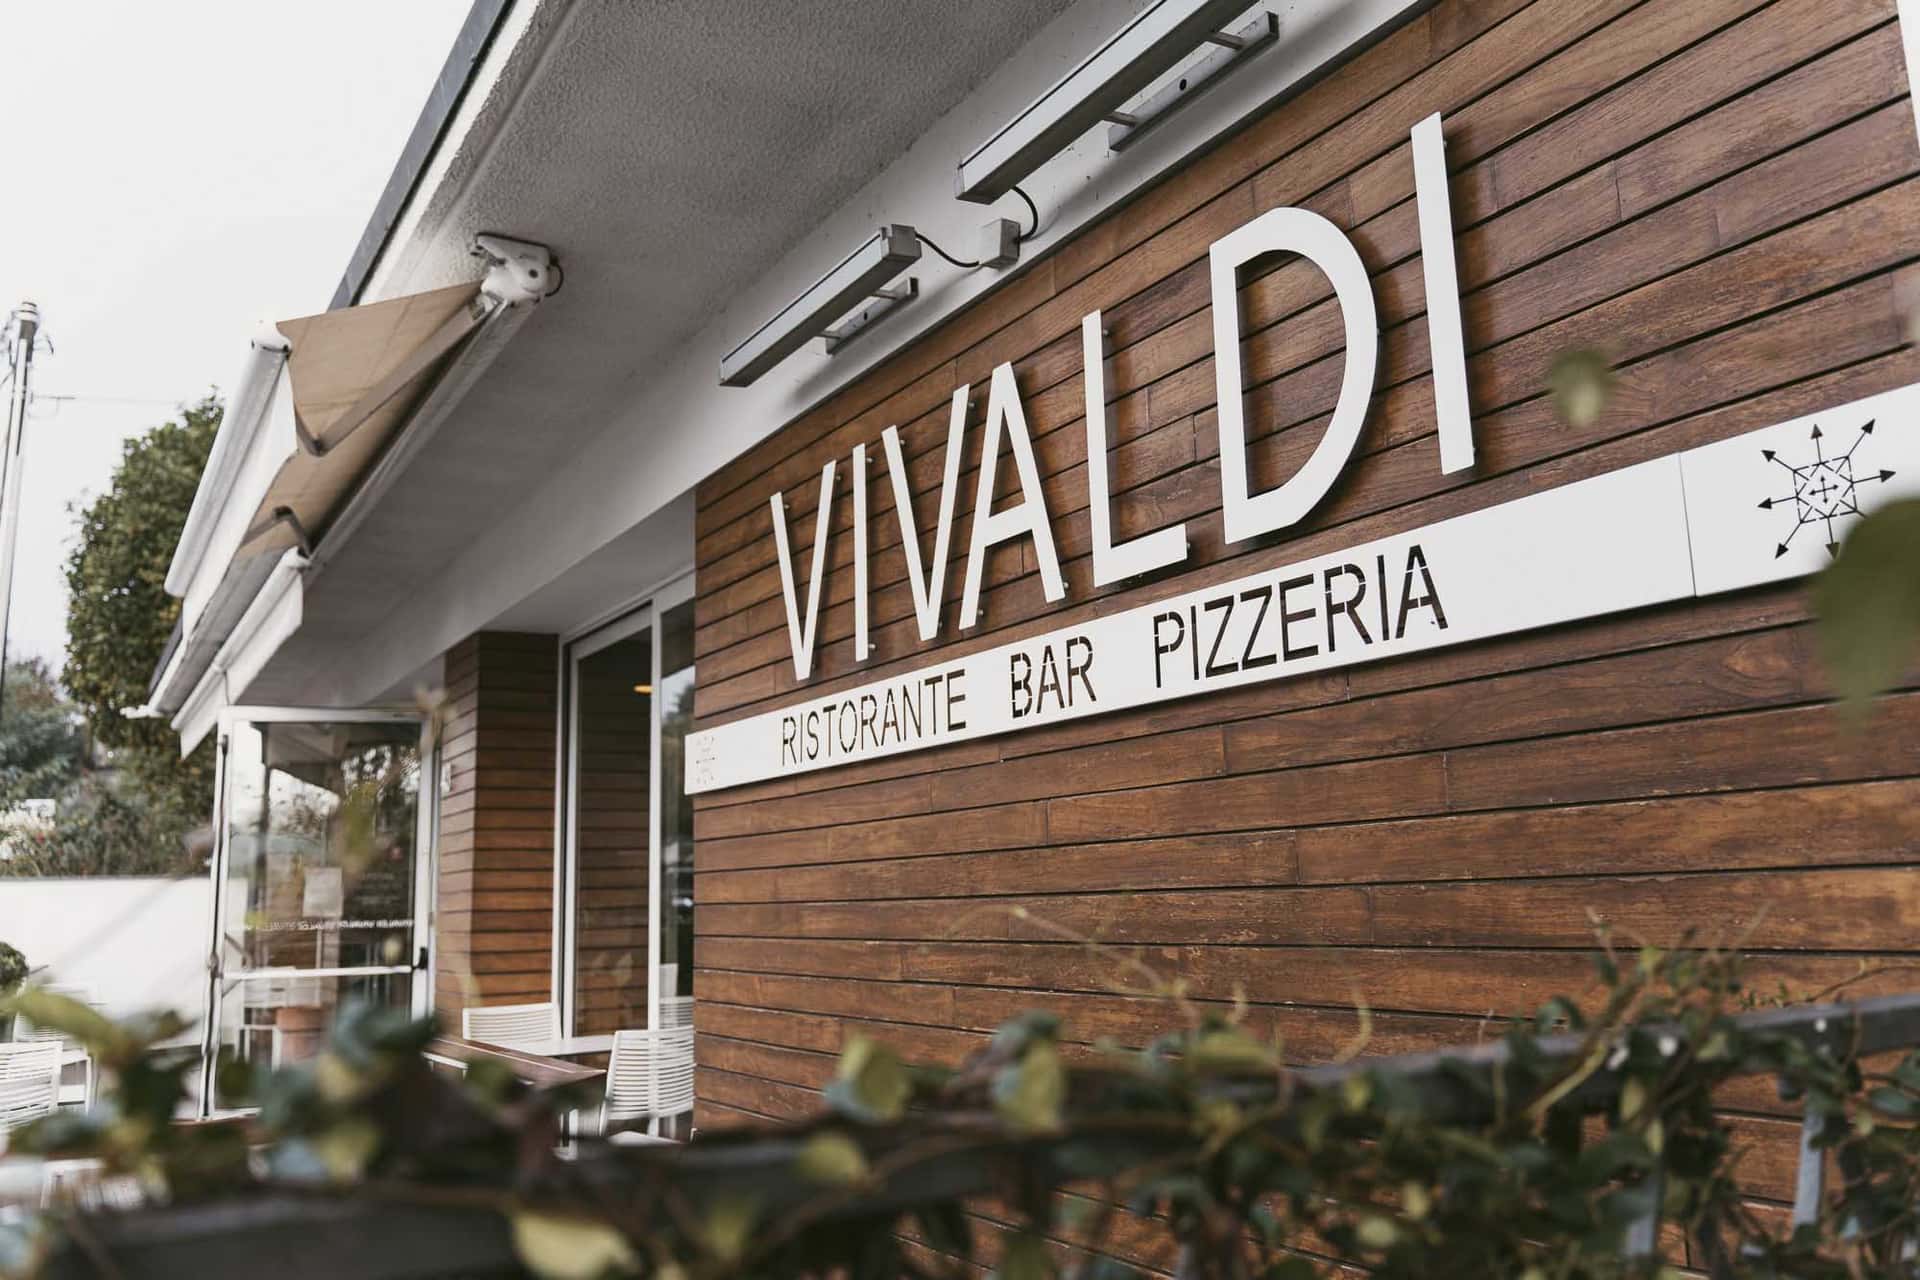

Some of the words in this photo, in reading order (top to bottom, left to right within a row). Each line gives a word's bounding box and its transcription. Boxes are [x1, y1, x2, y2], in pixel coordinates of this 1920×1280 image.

[769, 110, 1477, 681] VIVALDI
[781, 667, 968, 767] RISTORANTE
[1009, 635, 1098, 719] BAR
[1153, 544, 1449, 688] PIZZERIA
